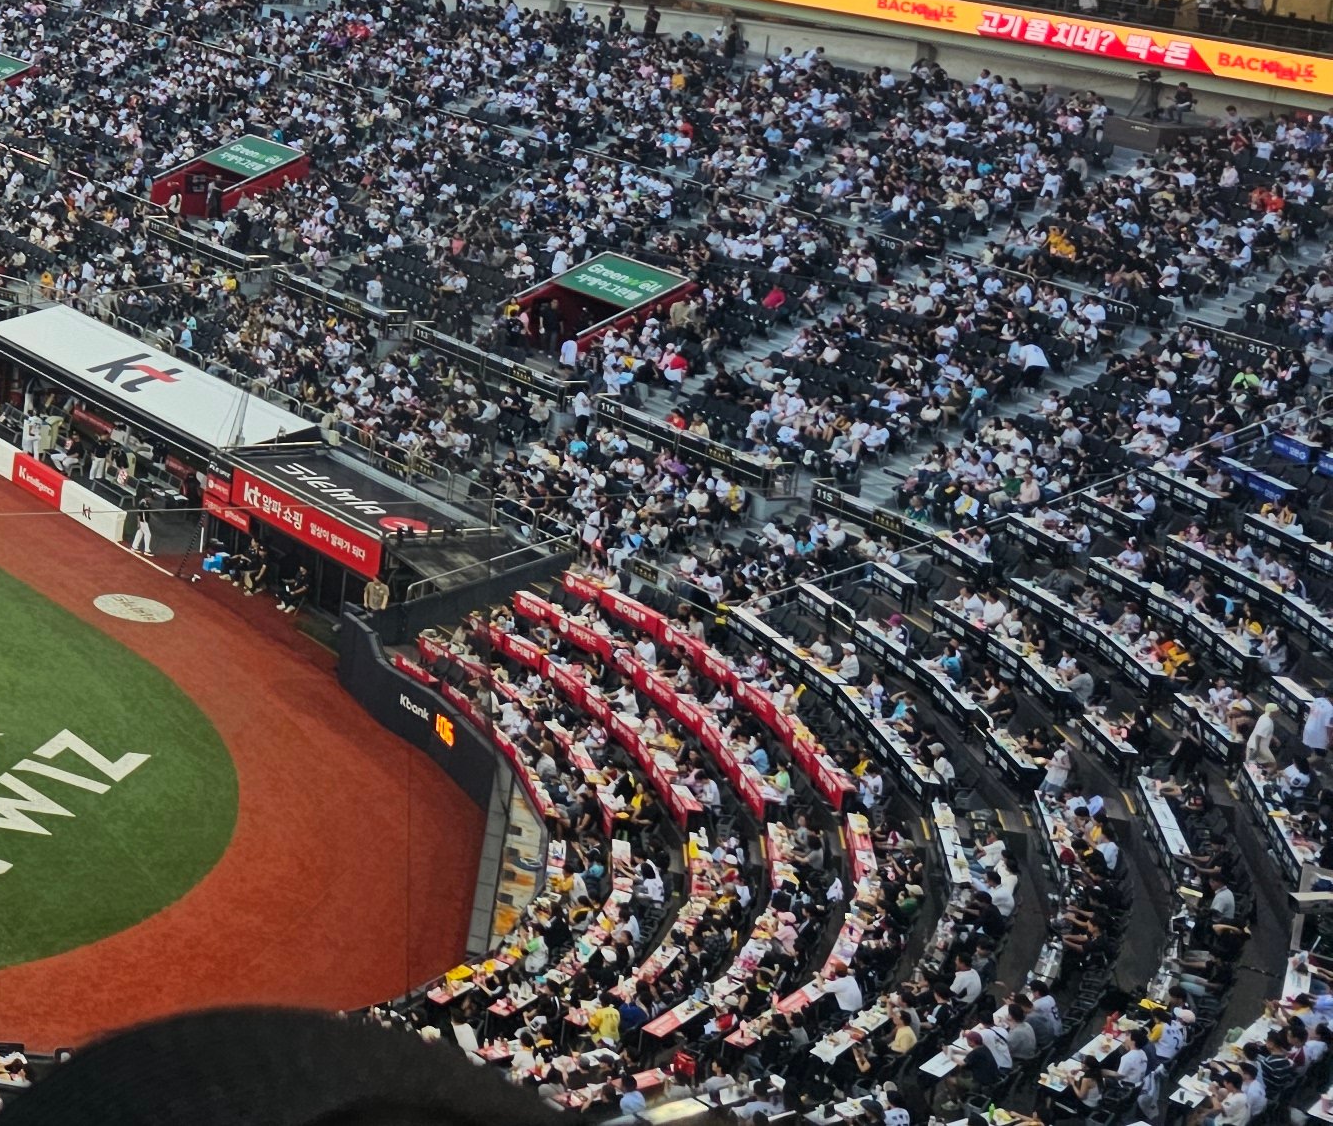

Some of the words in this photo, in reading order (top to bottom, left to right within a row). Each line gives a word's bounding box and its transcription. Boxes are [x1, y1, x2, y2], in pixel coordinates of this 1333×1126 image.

[978, 10, 1021, 38] 고기
[1052, 21, 1117, 53] 치네?
[1106, 302, 1124, 315] 311
[1247, 343, 1268, 357] 312
[85, 352, 185, 394] kt
[600, 401, 616, 414] 114
[26, 470, 55, 498] intelligence
[815, 487, 834, 503] 115
[82, 503, 92, 520] kt
[243, 481, 262, 508] kt
[262, 494, 282, 519] 알파
[282, 508, 304, 531] 쇼핑
[399, 693, 430, 722] Kbank
